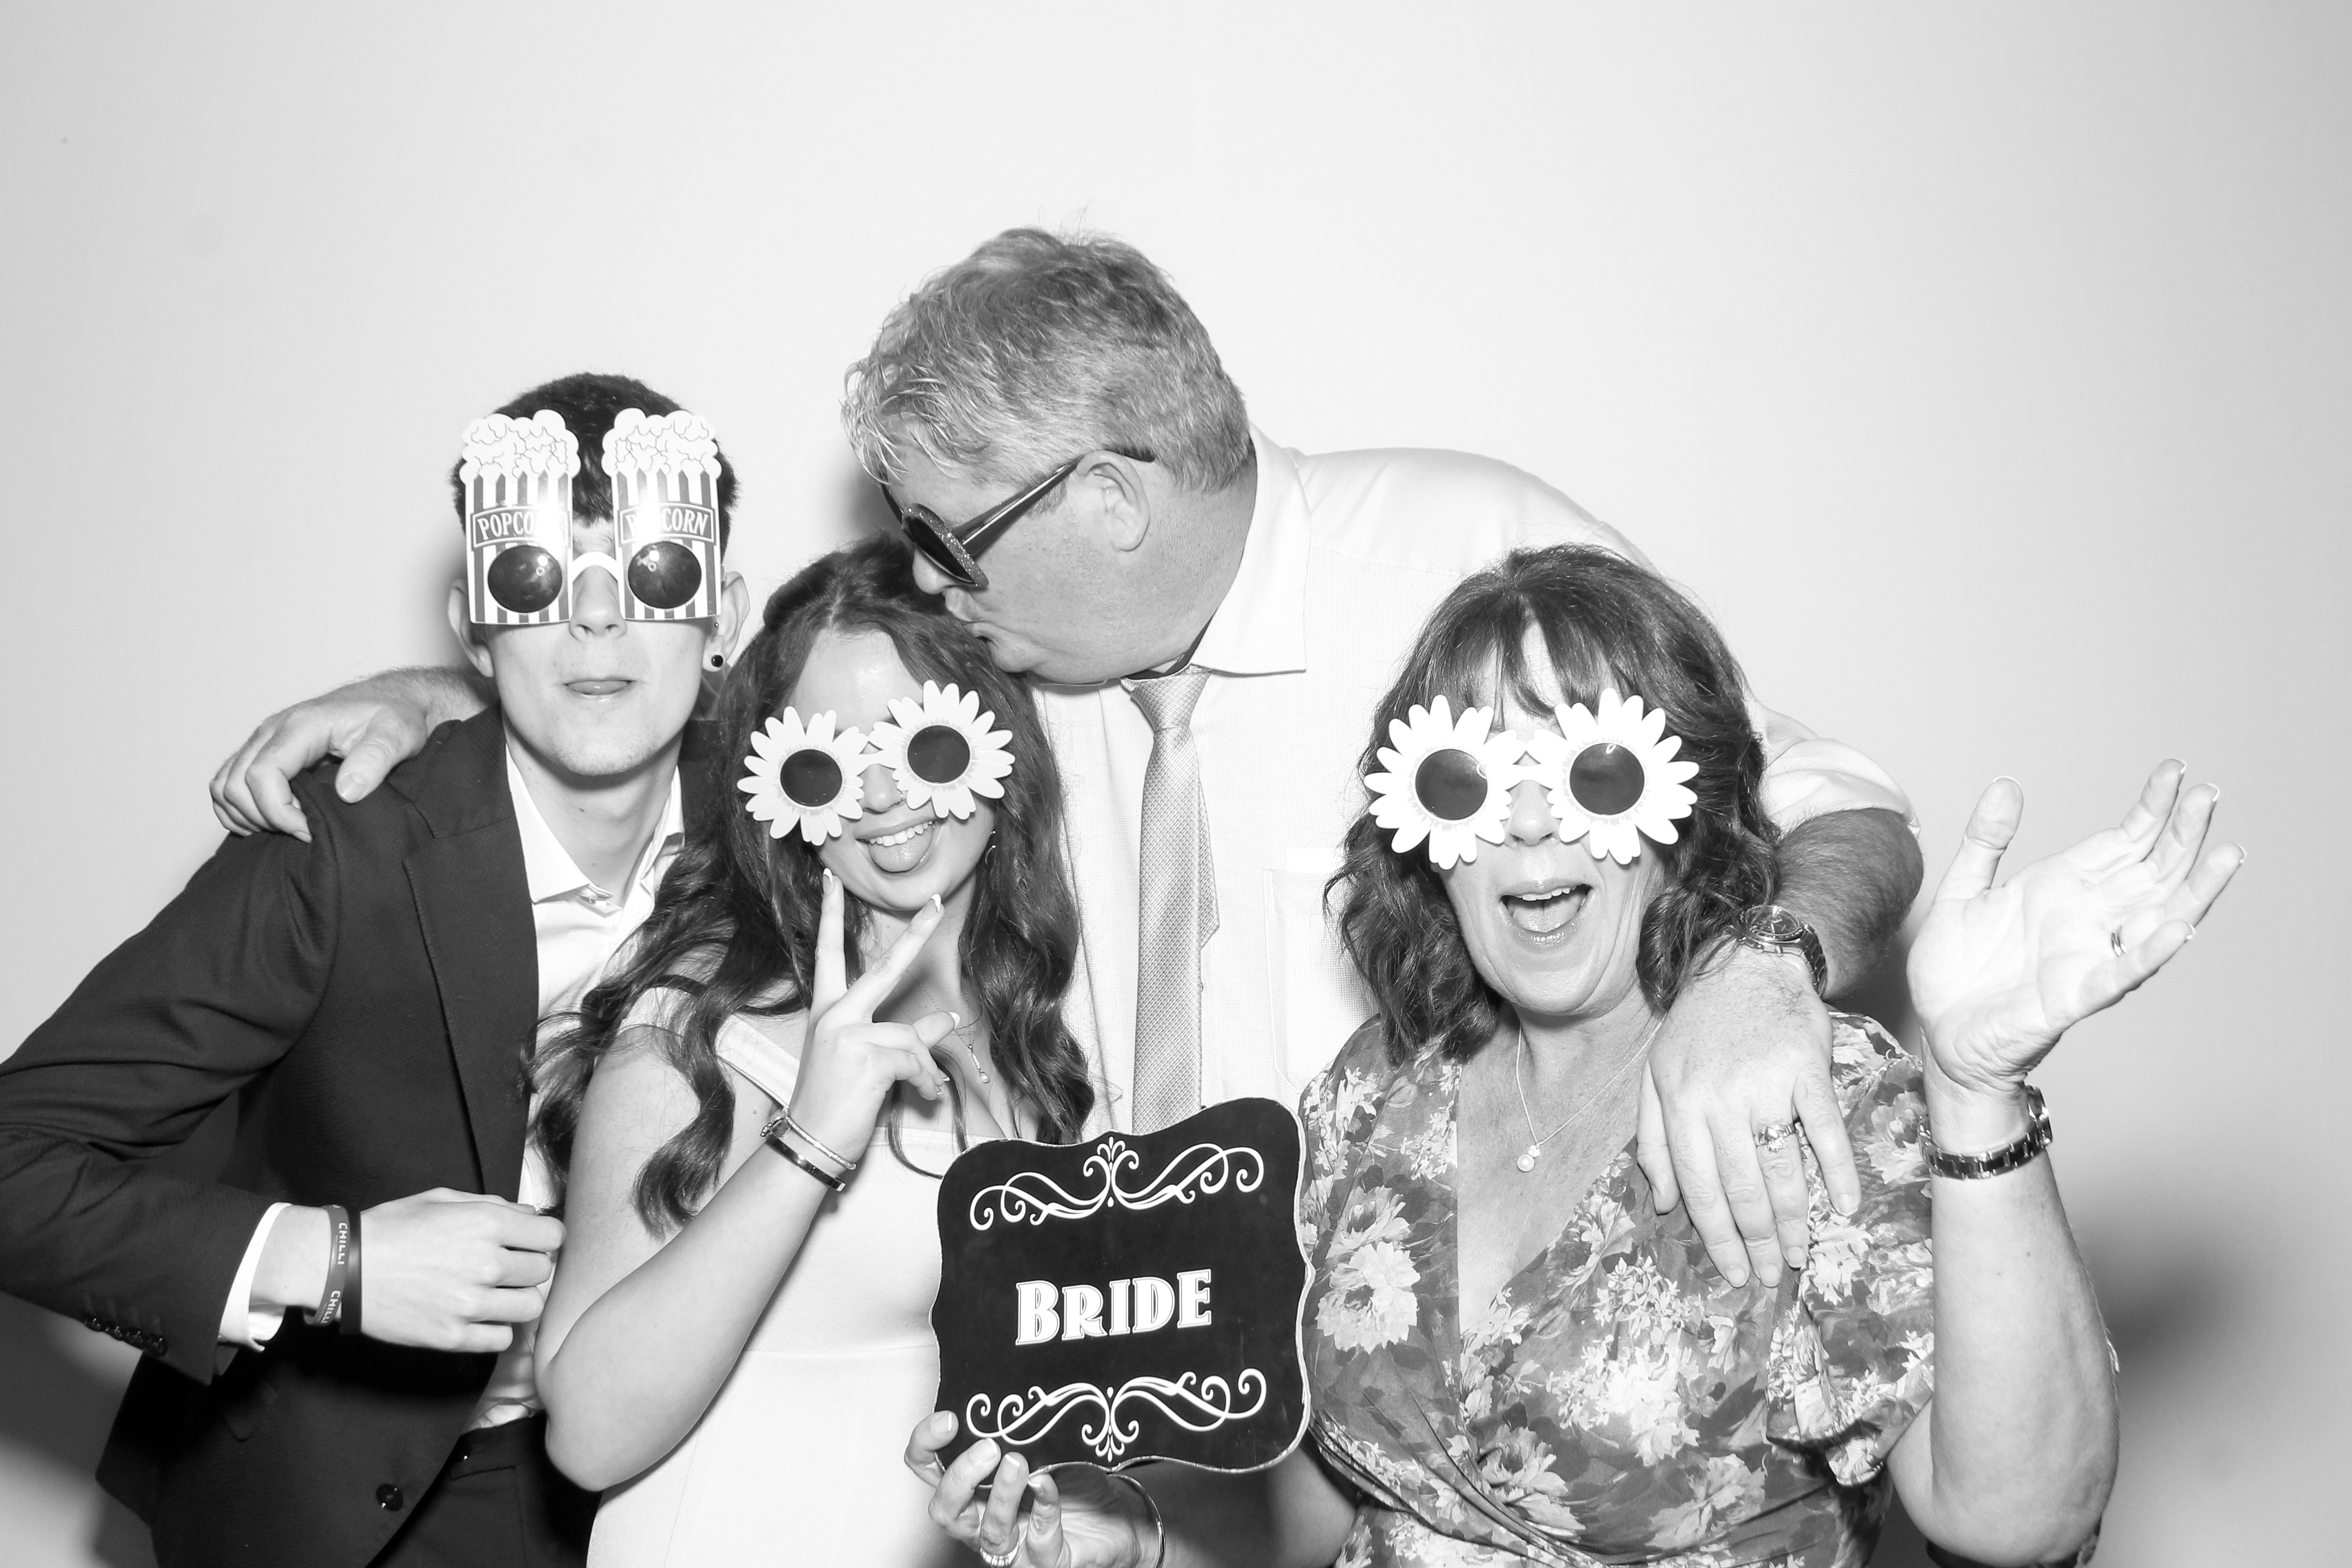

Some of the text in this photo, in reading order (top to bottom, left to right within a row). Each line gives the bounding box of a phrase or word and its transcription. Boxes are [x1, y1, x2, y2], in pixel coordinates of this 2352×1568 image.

[477, 511, 558, 541] POPCO
[625, 508, 709, 536] PCORN
[337, 1222, 348, 1265] CHILLI
[1015, 1268, 1212, 1346] BRIDE
